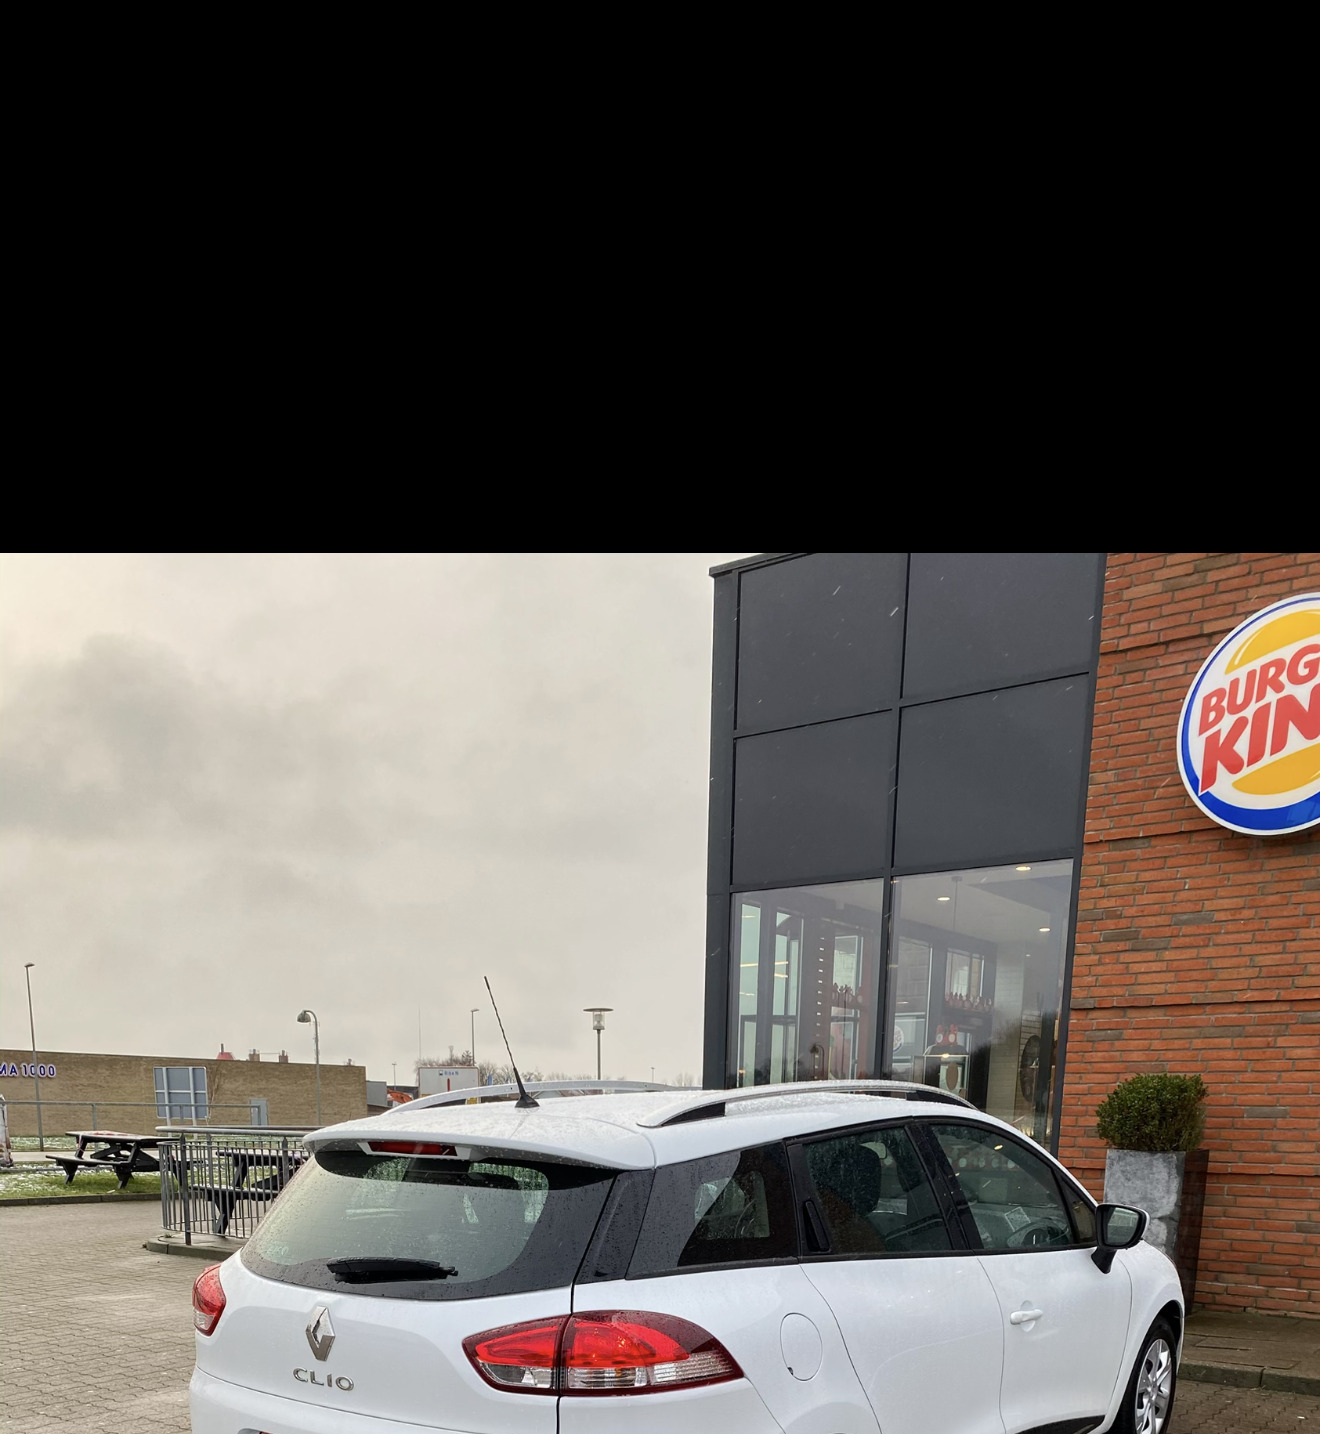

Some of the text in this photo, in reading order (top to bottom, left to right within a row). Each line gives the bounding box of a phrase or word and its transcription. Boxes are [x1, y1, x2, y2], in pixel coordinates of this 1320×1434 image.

[1198, 643, 1320, 737] BURG
[1200, 683, 1320, 793] KIN
[21, 1063, 56, 1078] 1000
[293, 1366, 355, 1392] CLIO
